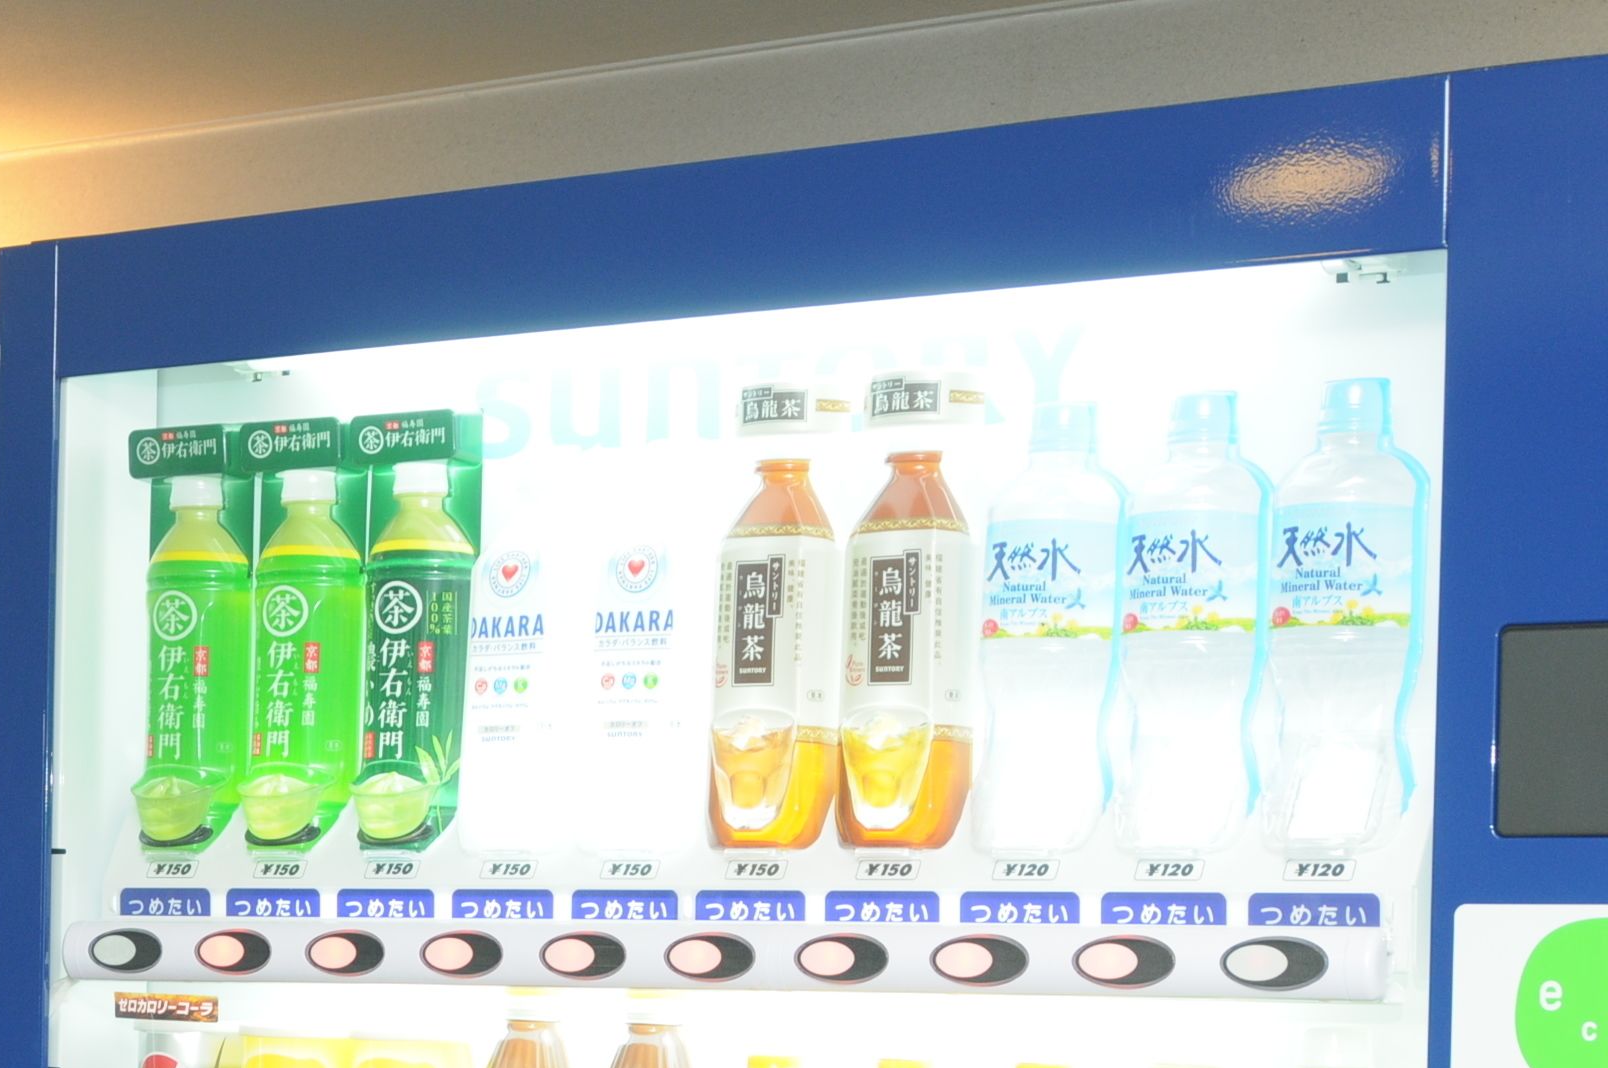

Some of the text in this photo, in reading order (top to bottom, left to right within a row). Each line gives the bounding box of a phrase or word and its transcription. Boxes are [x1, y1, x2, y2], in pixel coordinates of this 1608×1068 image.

[744, 396, 800, 420] 烏龍茶
[872, 390, 934, 414] 烏龍茶
[162, 439, 216, 458] 伊右衛門
[274, 432, 331, 451] 伊右衛門
[386, 427, 445, 448] 伊右衛門
[1128, 530, 1222, 576] 天然水
[1278, 522, 1378, 568] 天然水
[988, 538, 1081, 582] 天然水
[908, 555, 918, 608] サントリー
[1142, 572, 1187, 584] Natural
[1295, 568, 1341, 579] Natural
[771, 560, 781, 614] サントリー
[1003, 582, 1046, 592] Natural
[1130, 586, 1208, 600] Mineral Water
[1280, 580, 1364, 593] Mineral Water
[990, 593, 1067, 606] Mineral Water
[442, 592, 454, 635] 国産茶葉
[742, 572, 766, 662] 烏龍茶
[879, 567, 903, 659] 烏龍茶
[194, 647, 208, 674] 京都
[158, 646, 186, 760] 伊右衛門
[192, 681, 208, 729] 福寿園
[266, 642, 295, 758] 伊右衛門
[302, 677, 318, 727] 福寿園
[379, 638, 410, 760] 伊右衛門
[416, 677, 432, 728] 福寿園
[262, 864, 299, 875] ¥150
[610, 864, 652, 876] ¥150
[1003, 864, 1048, 876] ¥120
[128, 899, 202, 916] つめたい
[581, 900, 667, 918] つめたい
[970, 902, 1068, 923] つめたい
[118, 998, 213, 1016] ゼロカロリーコーラ
[1538, 980, 1563, 1011] e
[1580, 1020, 1598, 1041] c
